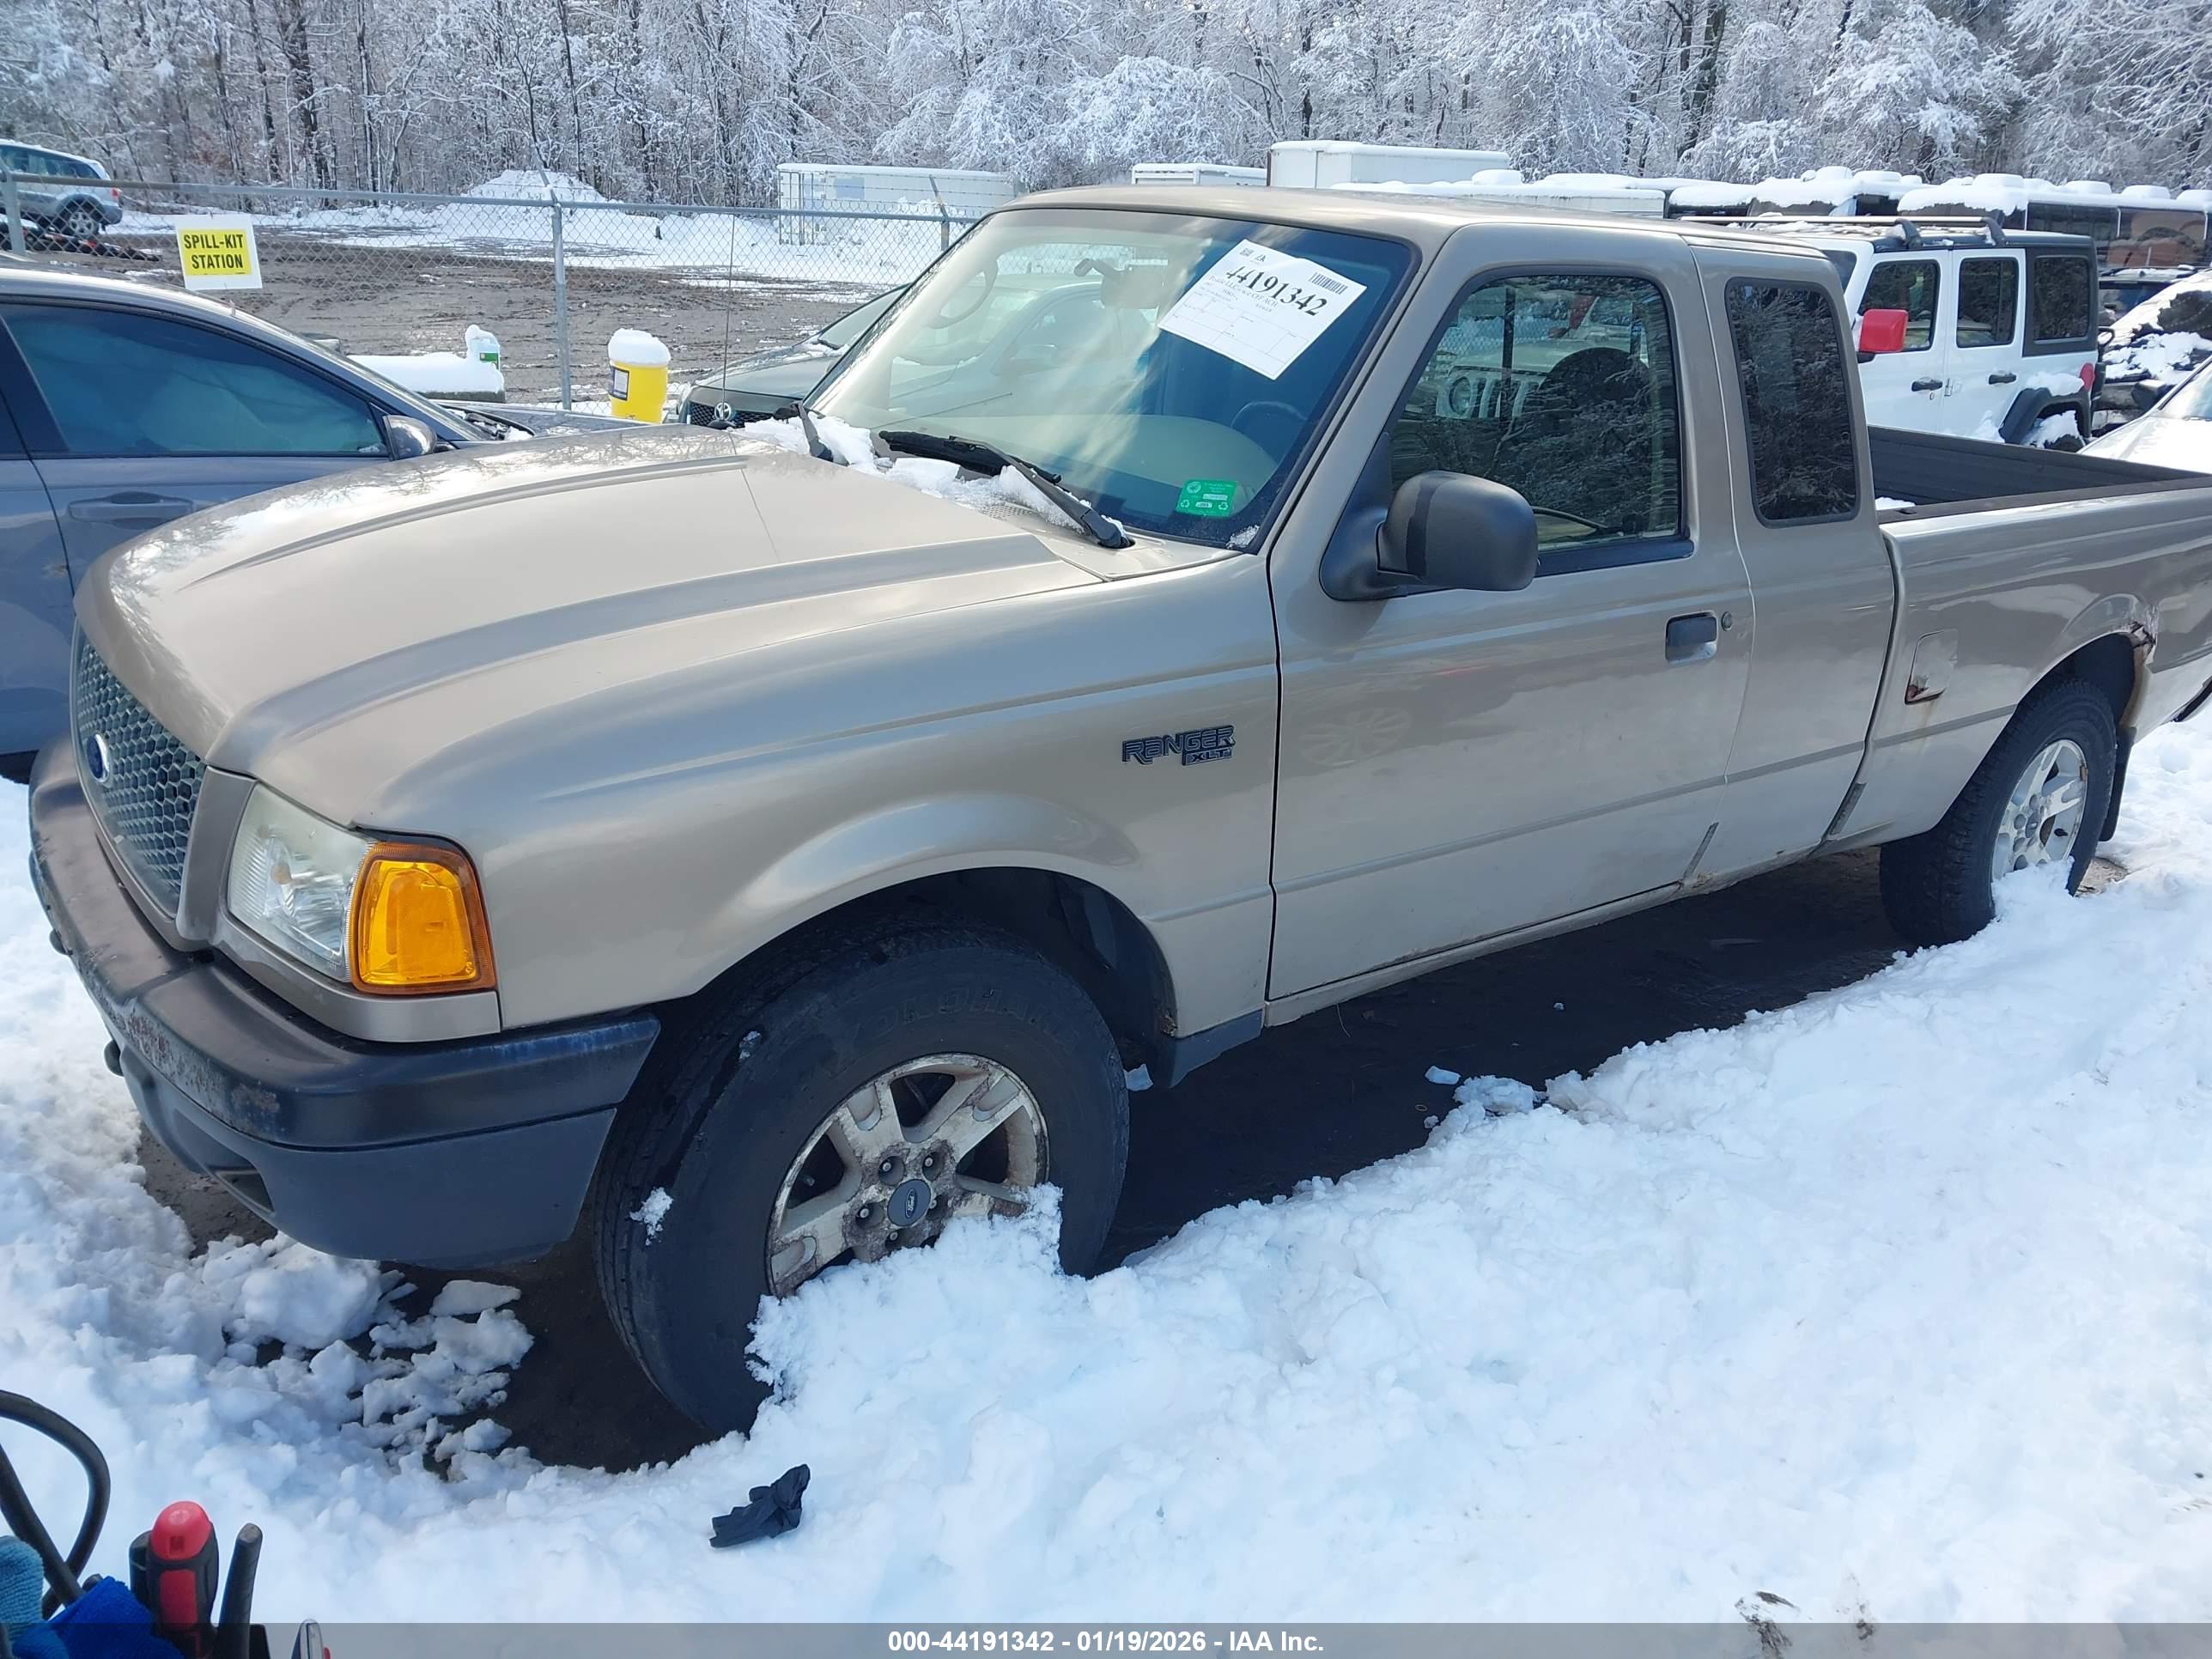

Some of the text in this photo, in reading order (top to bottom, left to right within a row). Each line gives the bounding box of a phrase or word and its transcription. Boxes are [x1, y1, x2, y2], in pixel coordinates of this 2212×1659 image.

[183, 234, 244, 250] SPILL-KIT
[191, 253, 244, 270] STATION
[1225, 265, 1328, 316] 44191342
[1122, 725, 1237, 764] RANGER
[1187, 746, 1231, 765] XLT
